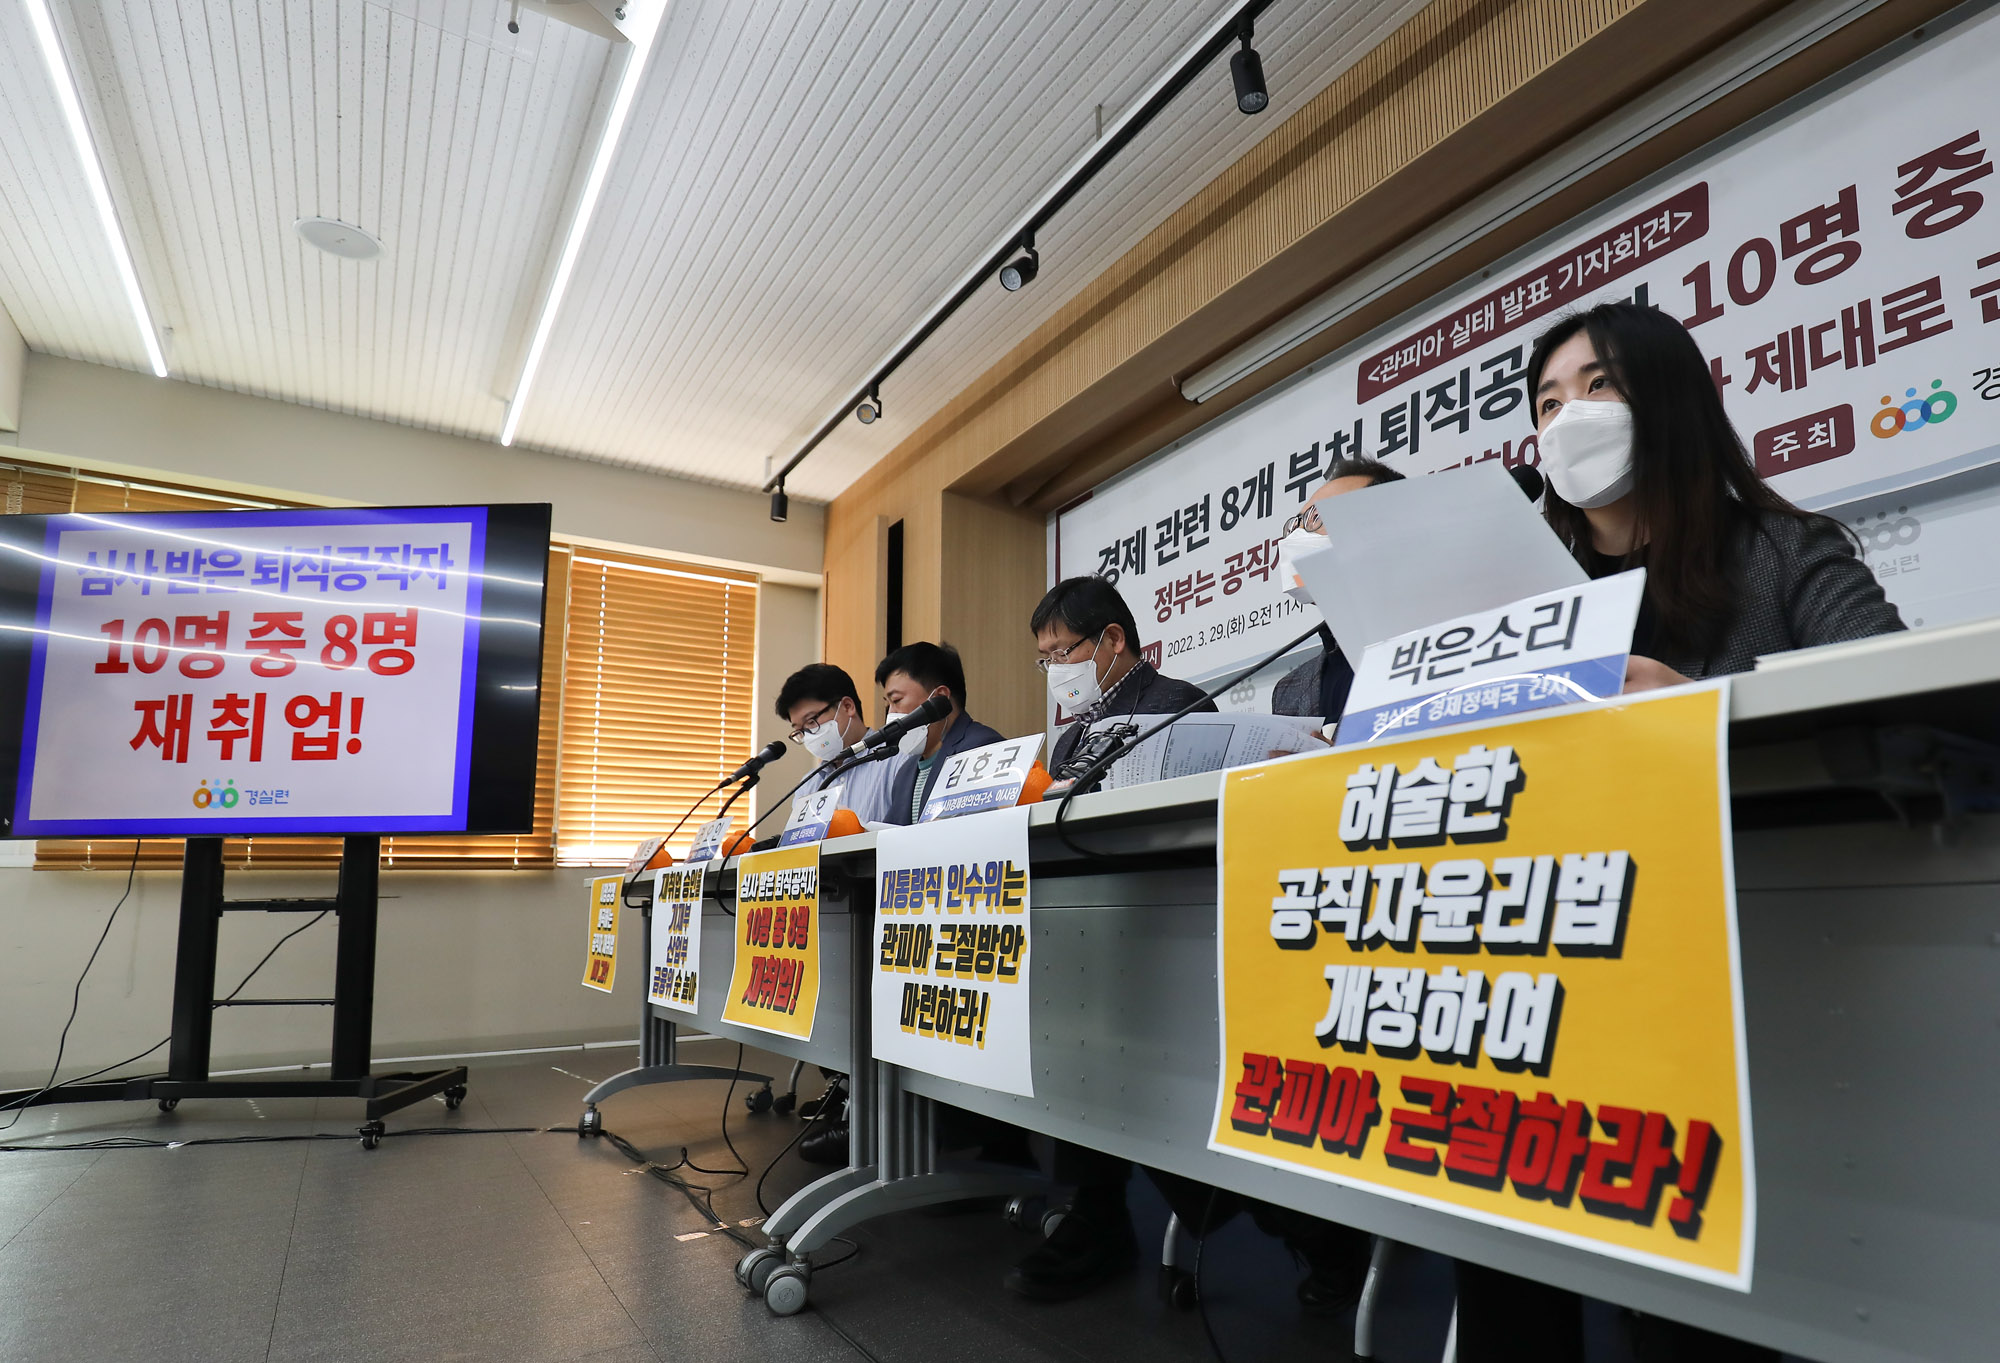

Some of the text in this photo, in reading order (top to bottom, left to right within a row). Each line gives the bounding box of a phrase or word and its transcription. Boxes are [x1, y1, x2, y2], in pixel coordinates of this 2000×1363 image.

[1367, 209, 1693, 384] <관피아 실태 발표 기자회견>
[1098, 526, 1147, 587] 경제
[1154, 493, 1210, 567] 관련
[1220, 462, 1275, 531] 8개
[1285, 418, 1363, 503] 부처
[1682, 183, 1862, 330] 10명
[1891, 129, 1994, 240] 중
[1154, 569, 1216, 624] 정부는
[1744, 275, 1954, 395] 제대로
[1770, 415, 1838, 464] 주최
[76, 543, 454, 596] 심사 받은 퇴직공직자
[94, 607, 419, 679] 10명 중 8명
[1167, 635, 1195, 658] 2022.
[1198, 631, 1207, 647] 3.
[1210, 614, 1245, 643] 29.(화)
[1247, 604, 1272, 629] 오전
[1275, 599, 1304, 619] 11시
[1388, 595, 1583, 686] 박은소리
[1427, 683, 1519, 722] 경제정책국
[1528, 671, 1572, 701] 간사
[244, 789, 290, 805] 경실련
[946, 745, 1021, 789] 김호균
[995, 786, 1019, 801] 이사장
[1337, 745, 1526, 852] 허술한
[740, 866, 817, 902] 심사 받은 퇴직공직자
[879, 859, 1027, 918] 대통령직 인수위는
[1269, 849, 1637, 959] 공직자윤리법
[746, 905, 810, 950] 10명 중 8명
[880, 923, 1027, 985] 관피아 근절방안
[741, 954, 805, 1016] 재취업!
[900, 981, 991, 1050] 마련하라!
[1314, 963, 1566, 1078] 개정하여
[1229, 1050, 1723, 1241] 관피아 근절하라!
